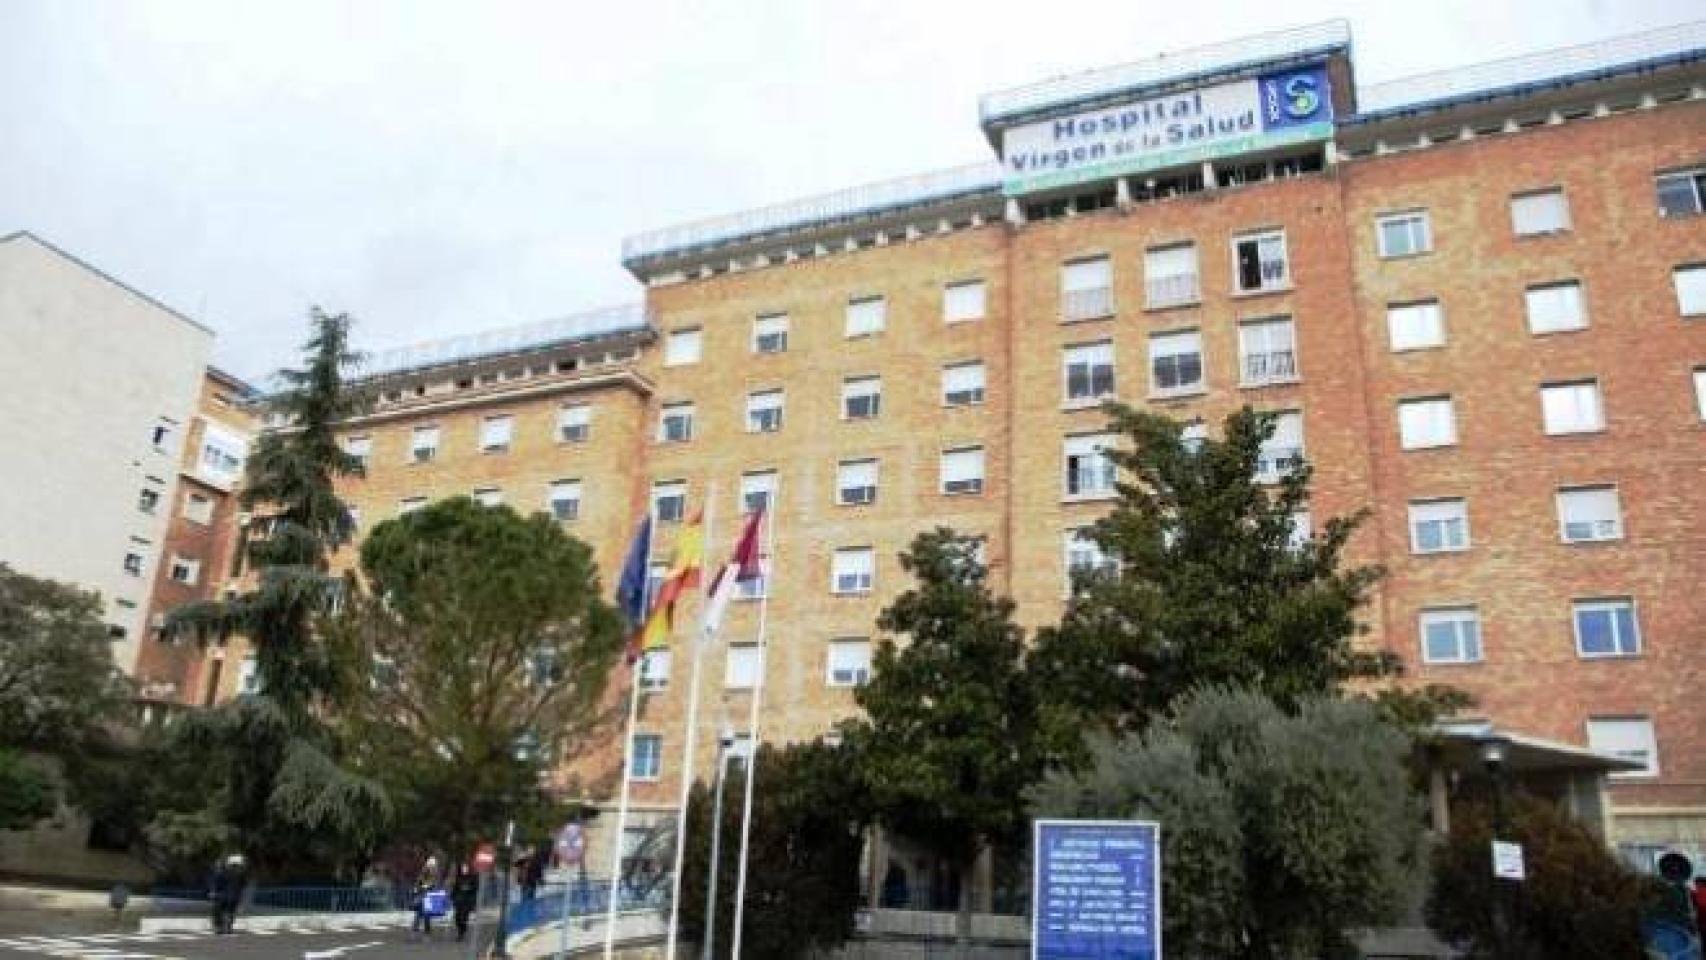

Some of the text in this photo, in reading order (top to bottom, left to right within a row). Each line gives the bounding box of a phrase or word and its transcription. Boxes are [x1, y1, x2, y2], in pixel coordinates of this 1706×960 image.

[1010, 142, 1106, 170] Virgen
[1166, 109, 1254, 143] Salud
[1054, 93, 1202, 139] Hospital
